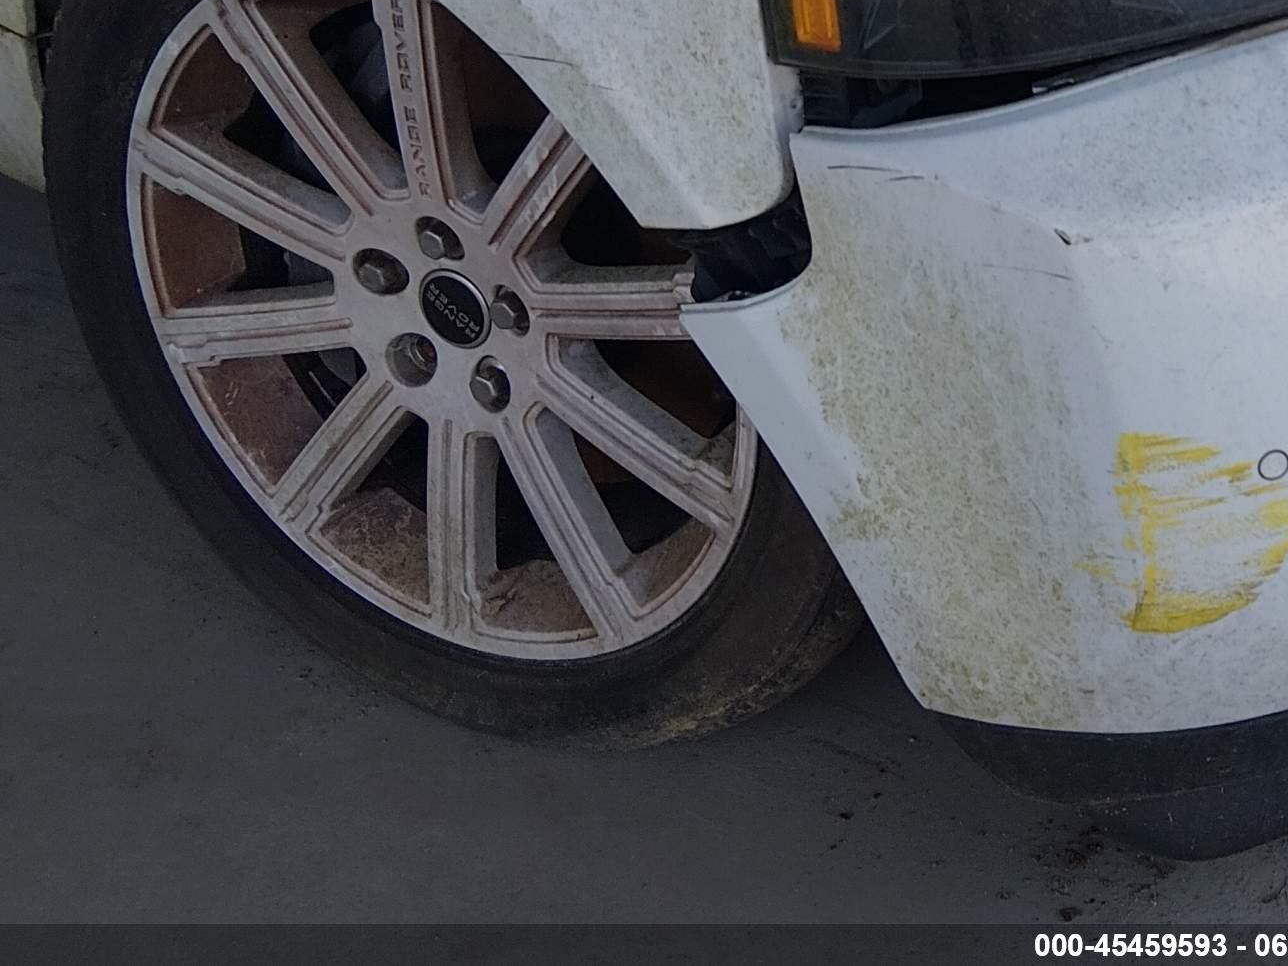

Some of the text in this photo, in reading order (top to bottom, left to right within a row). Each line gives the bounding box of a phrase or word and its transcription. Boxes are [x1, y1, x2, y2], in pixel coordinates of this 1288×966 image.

[404, 105, 432, 199] RANGE
[425, 290, 476, 338] RANGE
[429, 282, 480, 332] ROVER
